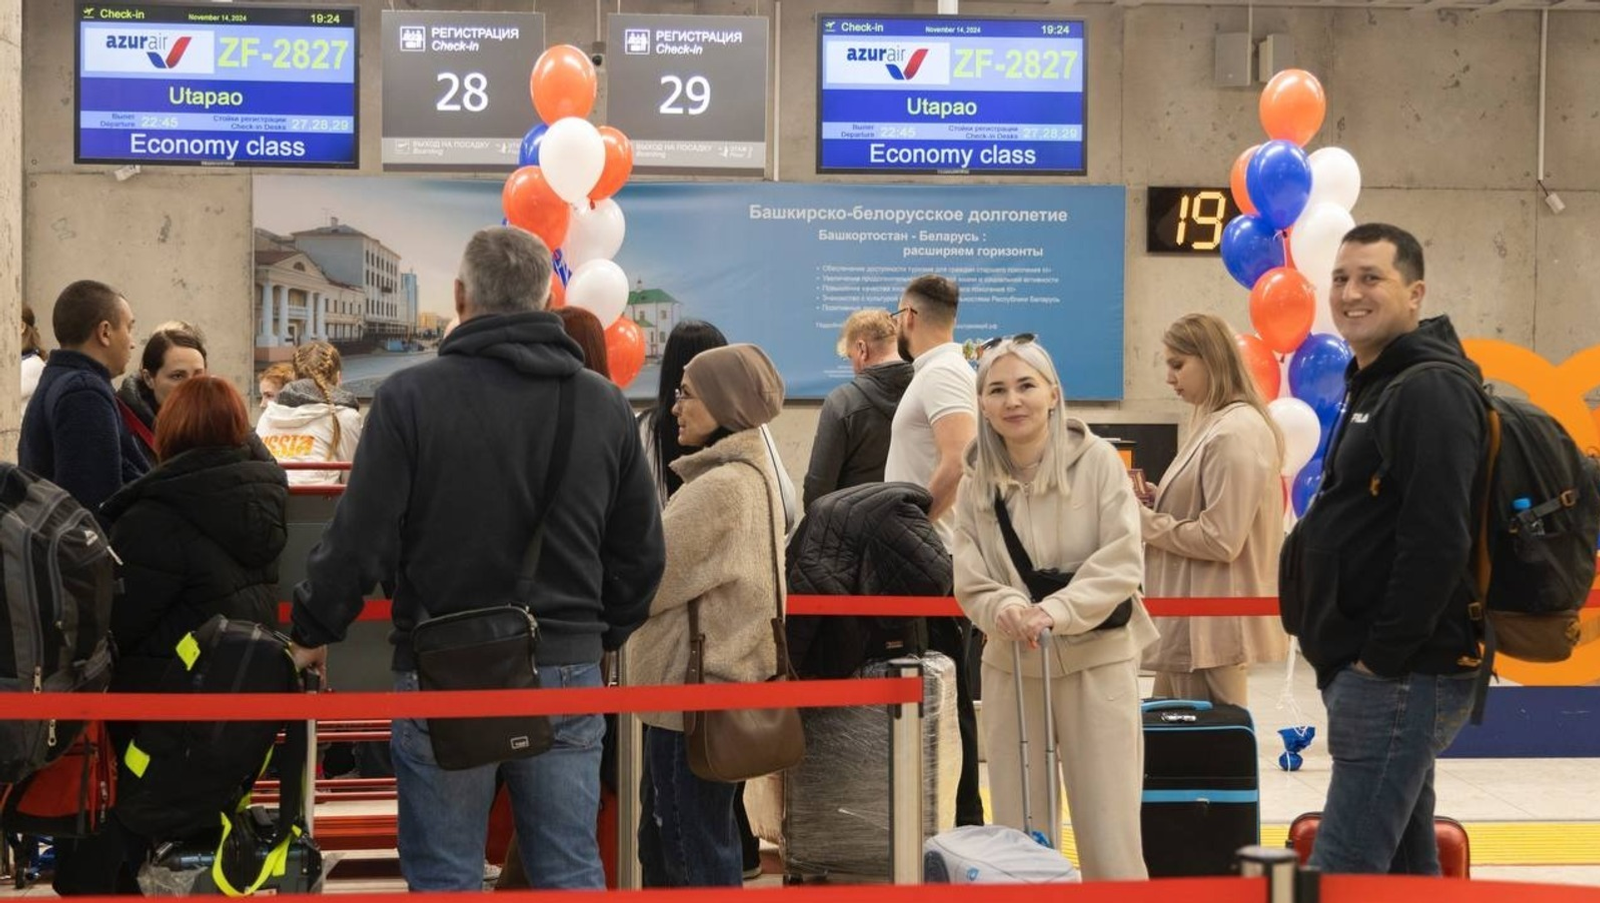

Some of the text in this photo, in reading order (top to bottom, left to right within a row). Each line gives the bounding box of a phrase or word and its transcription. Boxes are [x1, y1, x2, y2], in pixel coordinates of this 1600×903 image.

[100, 8, 145, 20] Check-in
[310, 13, 340, 24] 19:24
[431, 27, 519, 41] РЕГИСТРАЦИЯ
[841, 22, 884, 33] Check-in
[1041, 25, 1070, 35] 19:24
[106, 34, 168, 50] azurair
[656, 30, 743, 45] РЕГИСТРАЦИЯ
[218, 36, 348, 70] ZF-2827
[431, 40, 479, 52] Check-in
[656, 43, 703, 55] Check-in
[846, 47, 906, 62] azurair
[953, 48, 1078, 79] ZF-2827
[169, 86, 243, 108] Utapao
[436, 72, 489, 112] 28
[659, 75, 711, 115] 29
[906, 97, 977, 118] Utapao
[141, 116, 178, 128] 22:45
[880, 127, 916, 138] 22:45
[130, 133, 305, 159] Economy class
[870, 144, 1036, 168] Economy class
[749, 205, 1068, 224] Башкирско-белорусское долголетие
[1176, 191, 1226, 250] 19
[818, 230, 908, 243] Башкортостан
[919, 231, 979, 244] Беларусь
[903, 247, 1043, 258] расширяем горизонты
